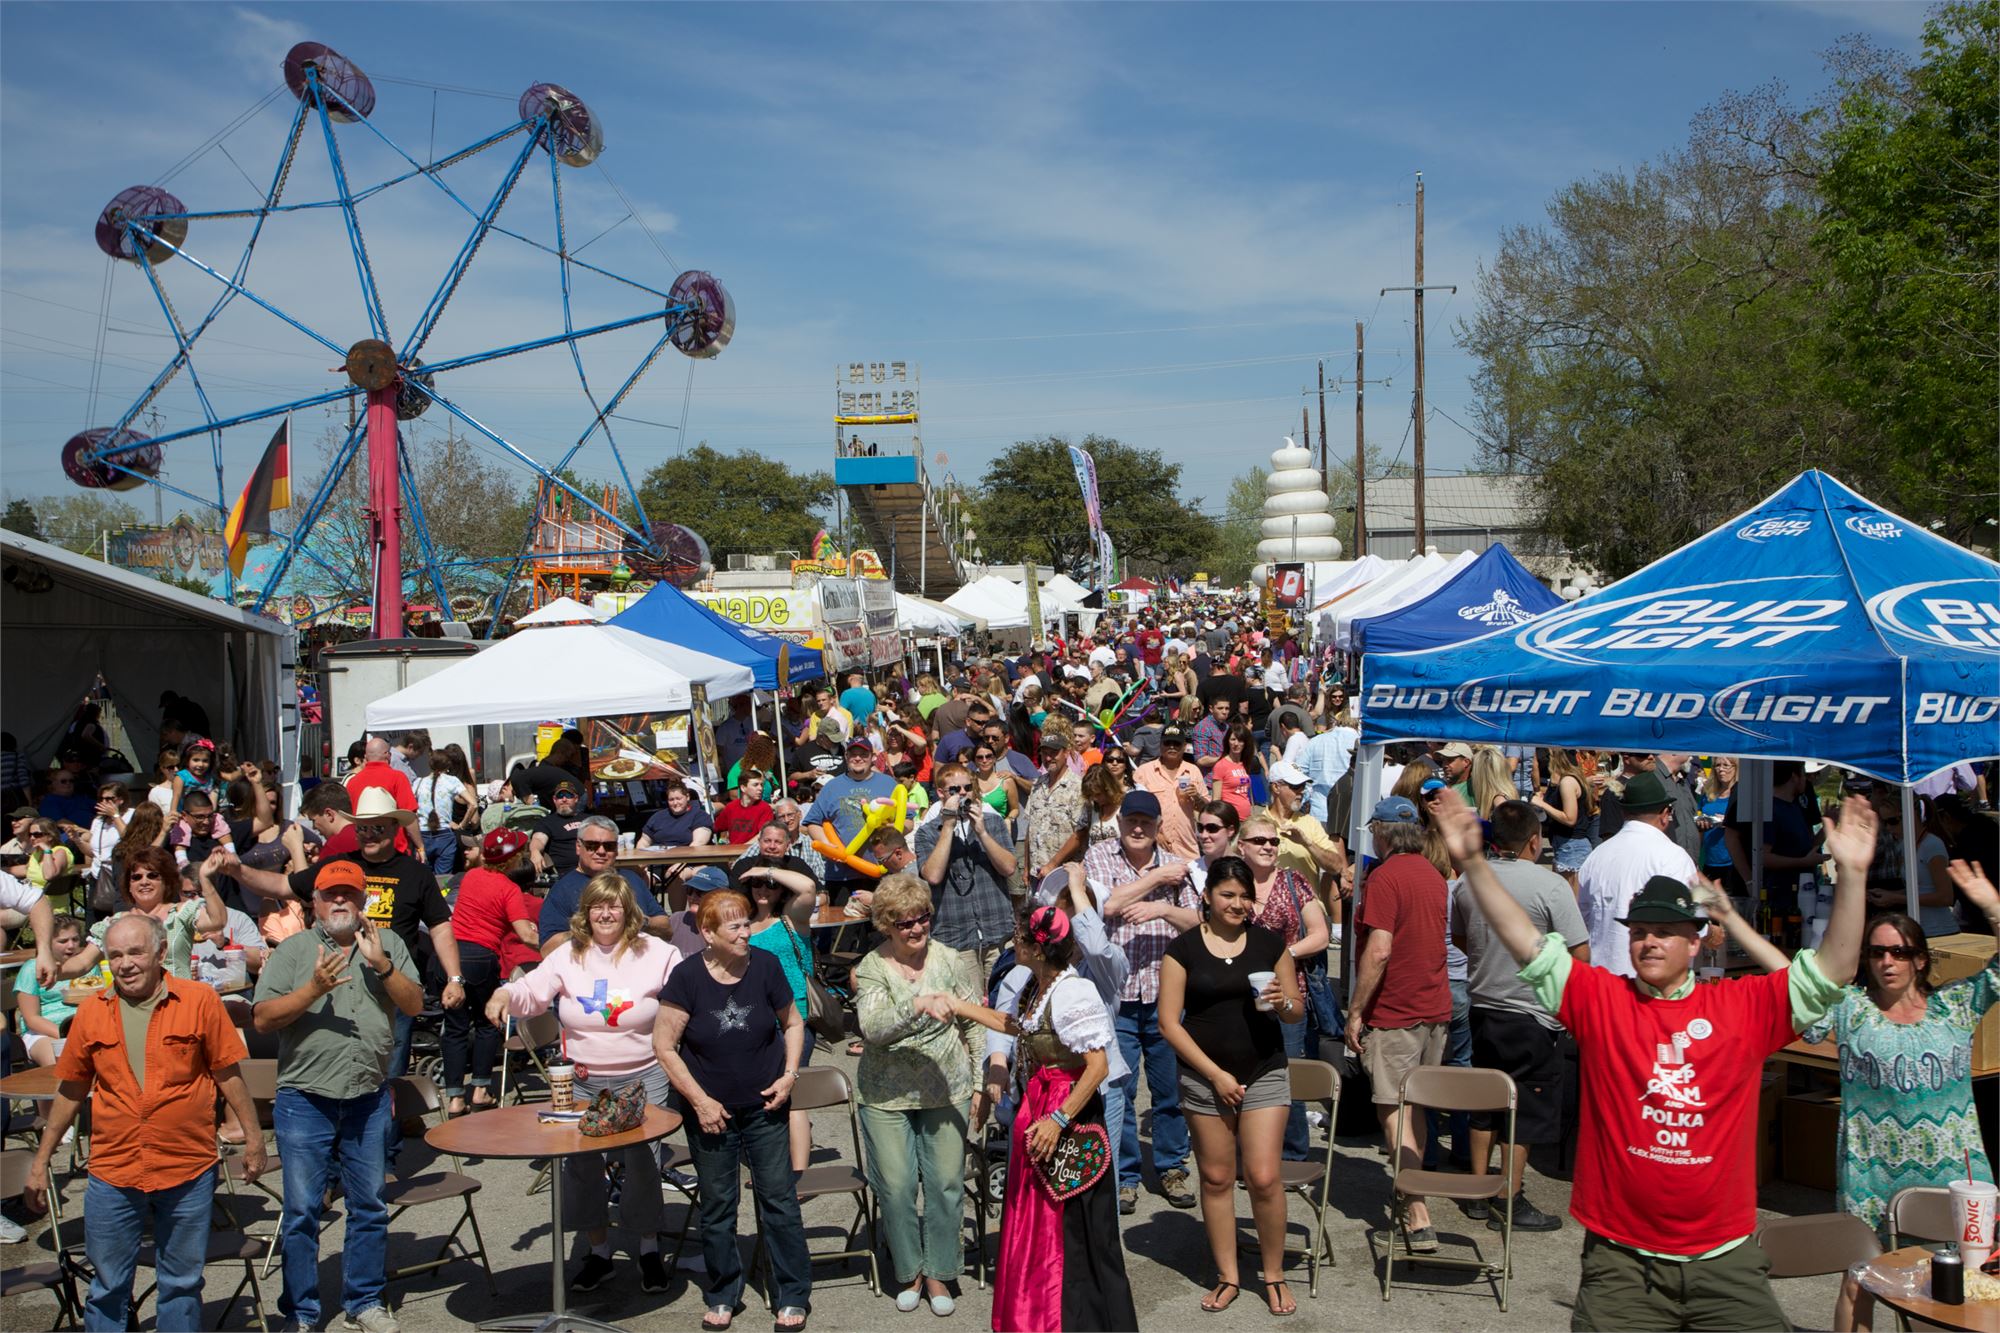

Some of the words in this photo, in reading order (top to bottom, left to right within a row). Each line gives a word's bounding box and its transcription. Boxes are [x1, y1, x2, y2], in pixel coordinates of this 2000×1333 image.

[1746, 528, 1811, 537] LIGHT
[1758, 520, 1812, 530] BUD
[794, 564, 825, 575] FUNNEL
[1458, 602, 1496, 617] Great
[1611, 599, 1848, 626] BUD
[1546, 625, 1840, 650] LIGHT
[1366, 684, 1450, 711] BUD
[1466, 687, 1591, 716] LIGHT
[1600, 688, 1705, 720] BUD
[1728, 694, 1891, 726] LIGHT
[1642, 1105, 1704, 1128] POLKA
[1058, 1137, 1080, 1158] üße
[1656, 1129, 1688, 1147] ON
[1048, 1158, 1082, 1182] Maus
[1967, 1199, 1980, 1243] SONIC
